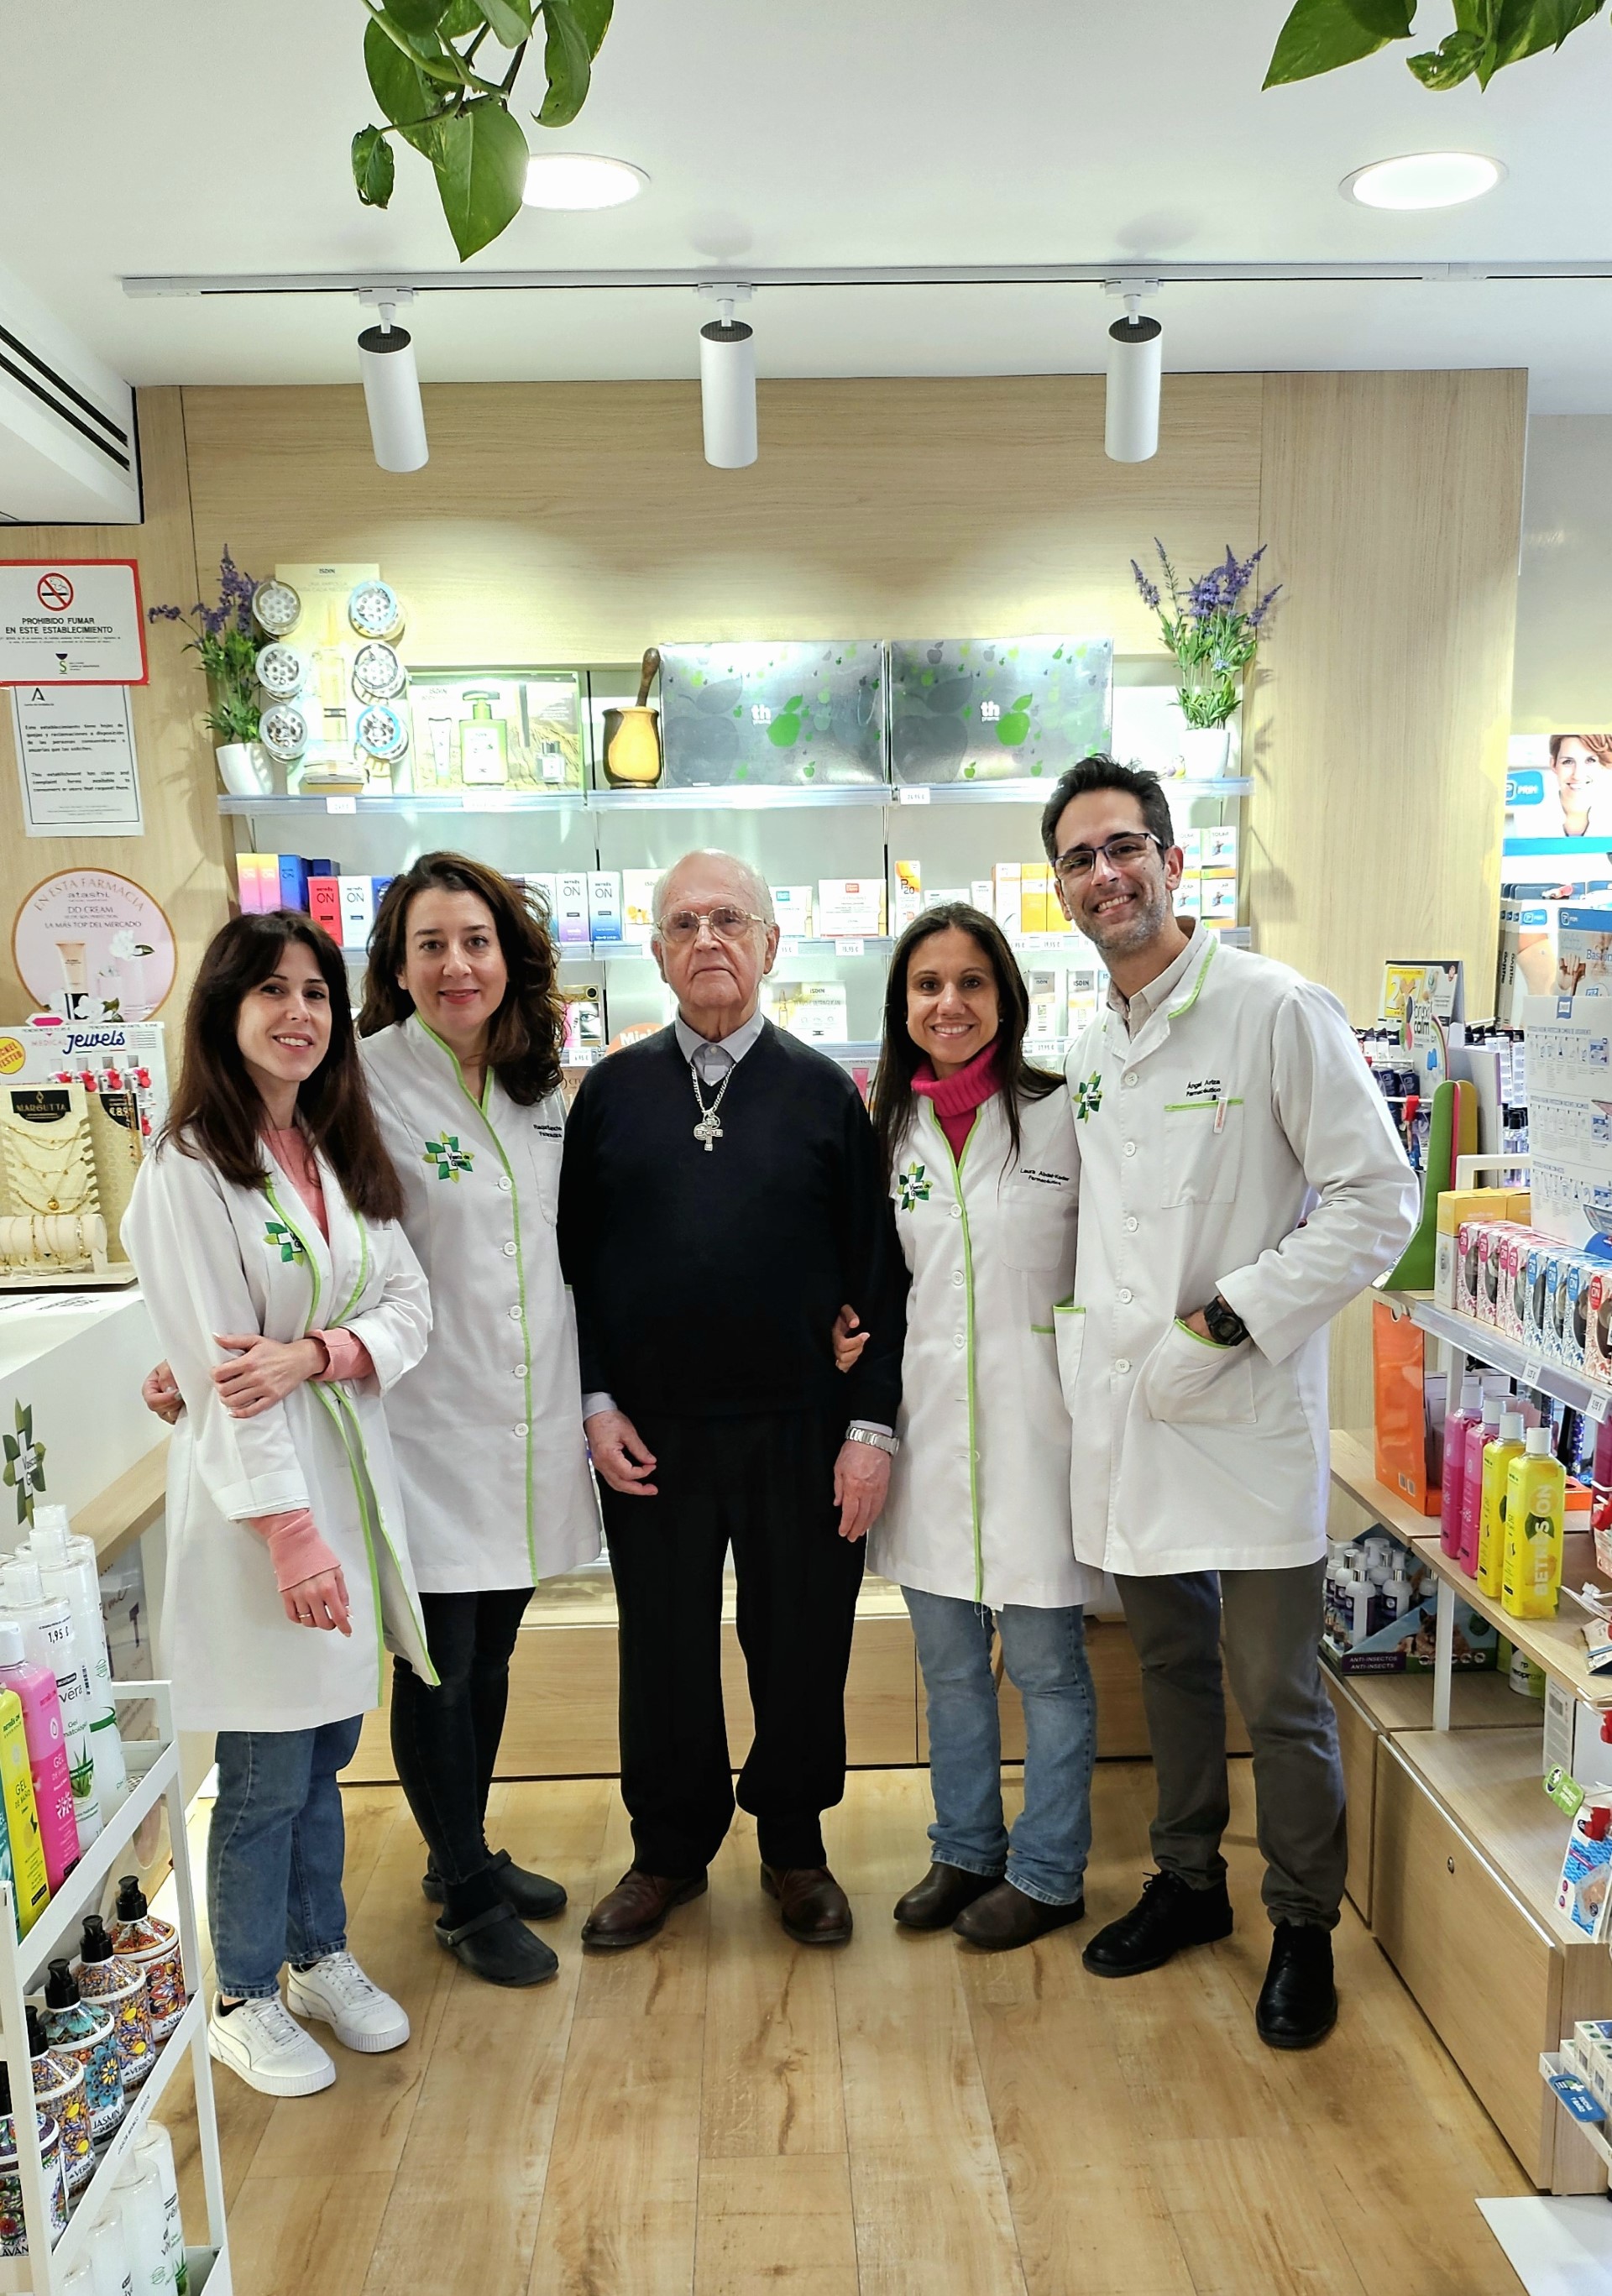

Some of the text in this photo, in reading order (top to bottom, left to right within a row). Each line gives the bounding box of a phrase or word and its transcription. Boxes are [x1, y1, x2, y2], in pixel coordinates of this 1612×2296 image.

[34, 896, 49, 911] EN
[81, 878, 144, 911] FARMACIA
[347, 892, 364, 902] ON
[563, 886, 580, 897] ON
[595, 888, 612, 898] ON
[317, 892, 334, 903] ON
[48, 1628, 64, 1644] 1,95
[15, 1779, 27, 1796] GEL
